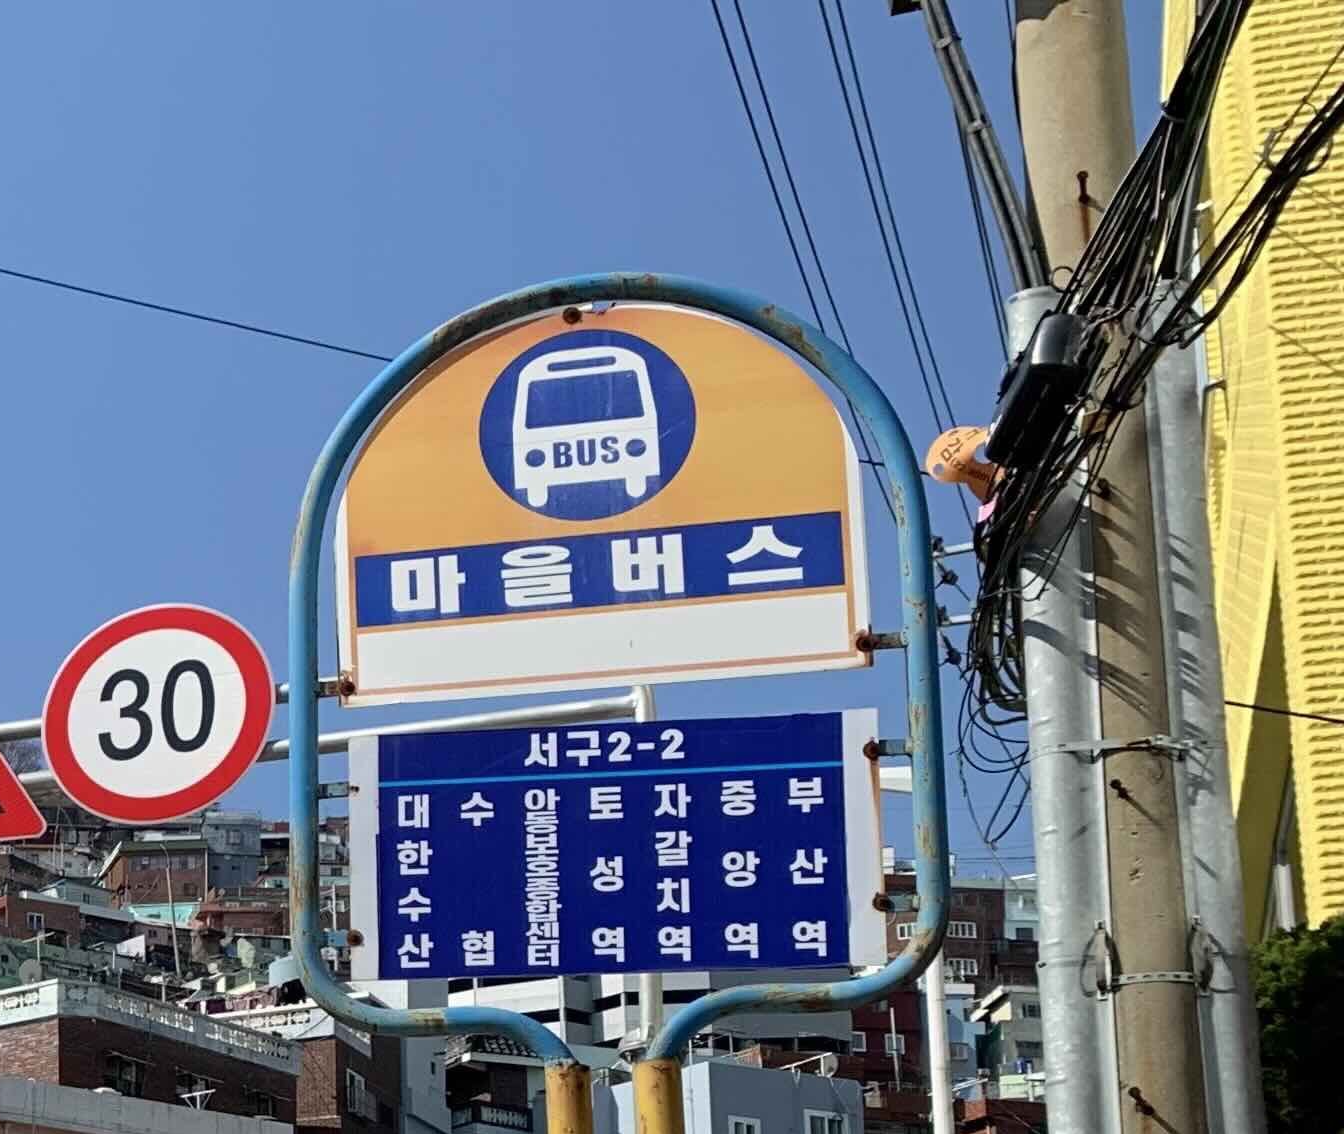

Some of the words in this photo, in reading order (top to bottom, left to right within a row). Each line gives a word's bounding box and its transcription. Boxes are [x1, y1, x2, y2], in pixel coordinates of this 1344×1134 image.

[553, 436, 620, 469] BUS
[390, 525, 804, 614] 마을버스
[98, 659, 215, 761] 30
[524, 728, 686, 767] 서구2-2
[524, 787, 561, 968] 아동보호종합센터
[589, 786, 625, 963] 토성역
[654, 783, 692, 963] 자갈치역
[721, 780, 760, 960] 중앙역
[788, 777, 828, 958] 부산역
